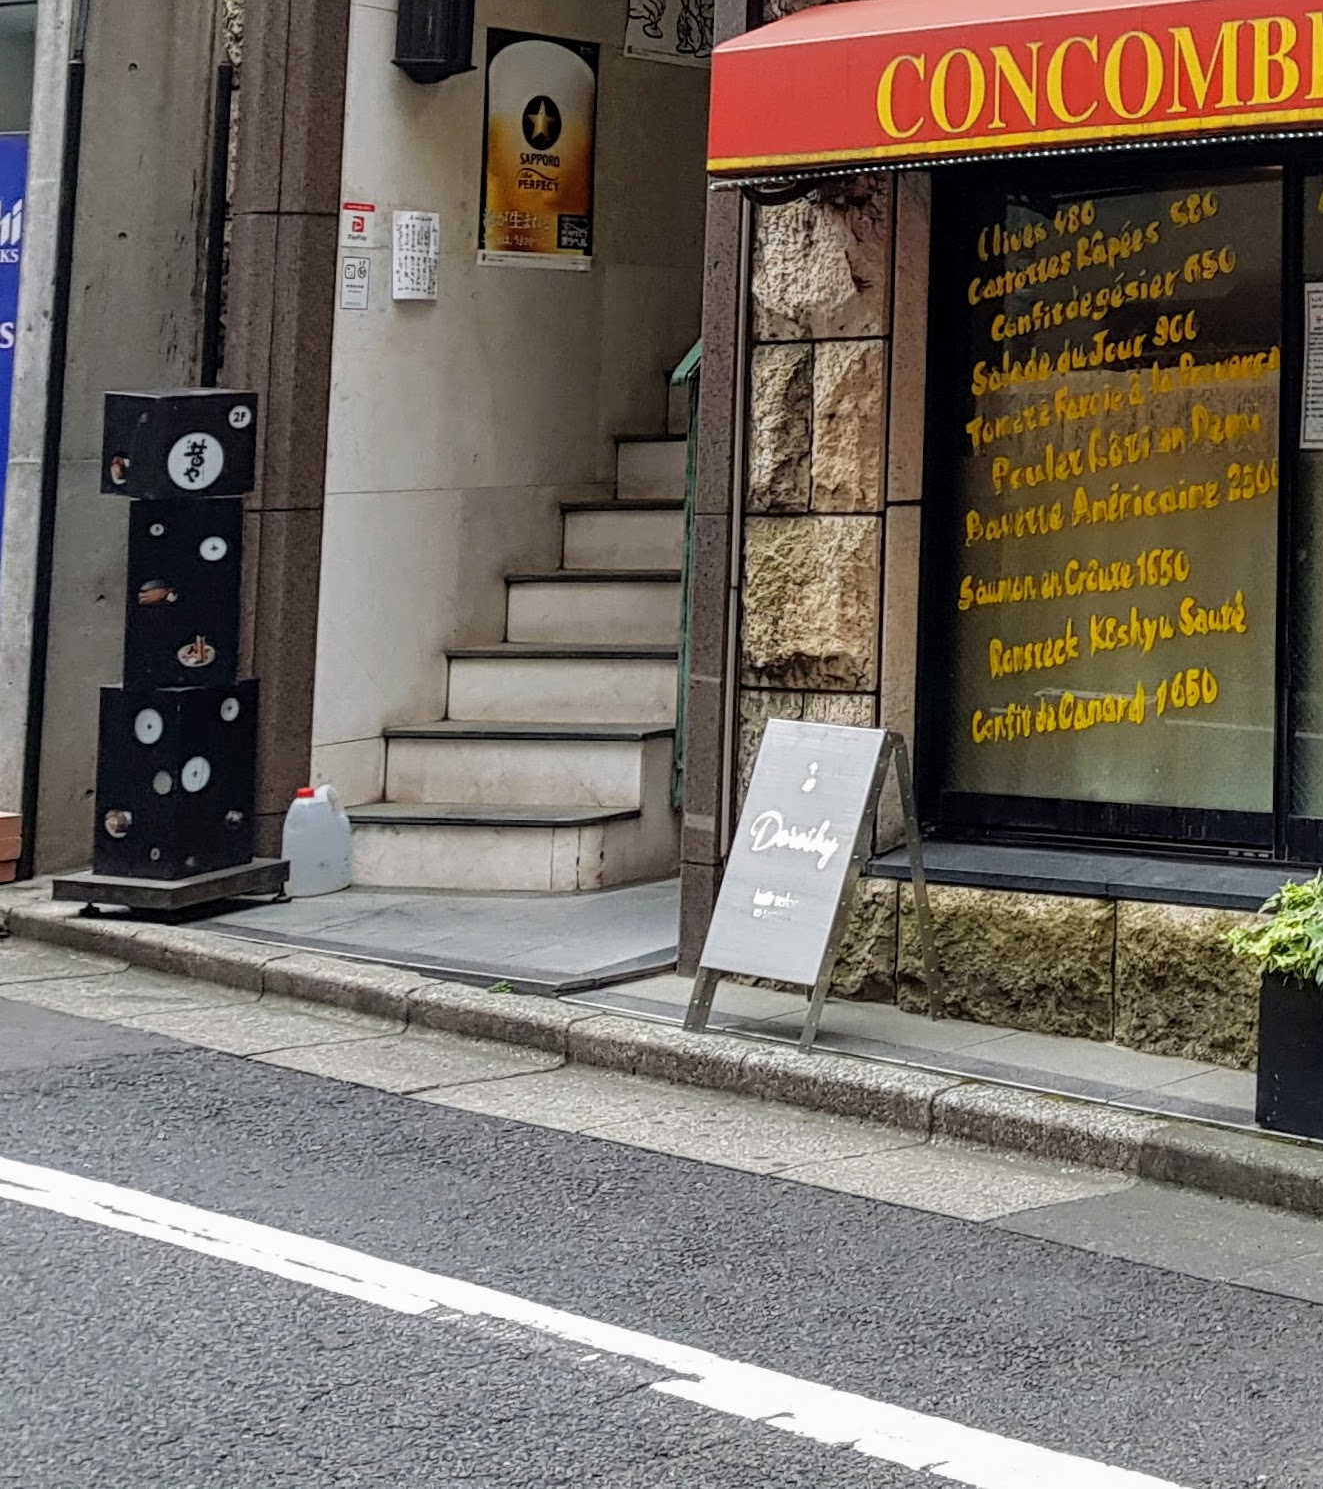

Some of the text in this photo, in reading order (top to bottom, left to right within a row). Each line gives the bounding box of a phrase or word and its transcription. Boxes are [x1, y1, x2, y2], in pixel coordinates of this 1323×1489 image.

[519, 152, 561, 168] SAPPORO
[517, 178, 560, 192] PERFECT
[1053, 199, 1096, 236] 480
[232, 411, 247, 423] 2F
[1136, 546, 1192, 588] 1650
[1156, 666, 1220, 717] 1650
